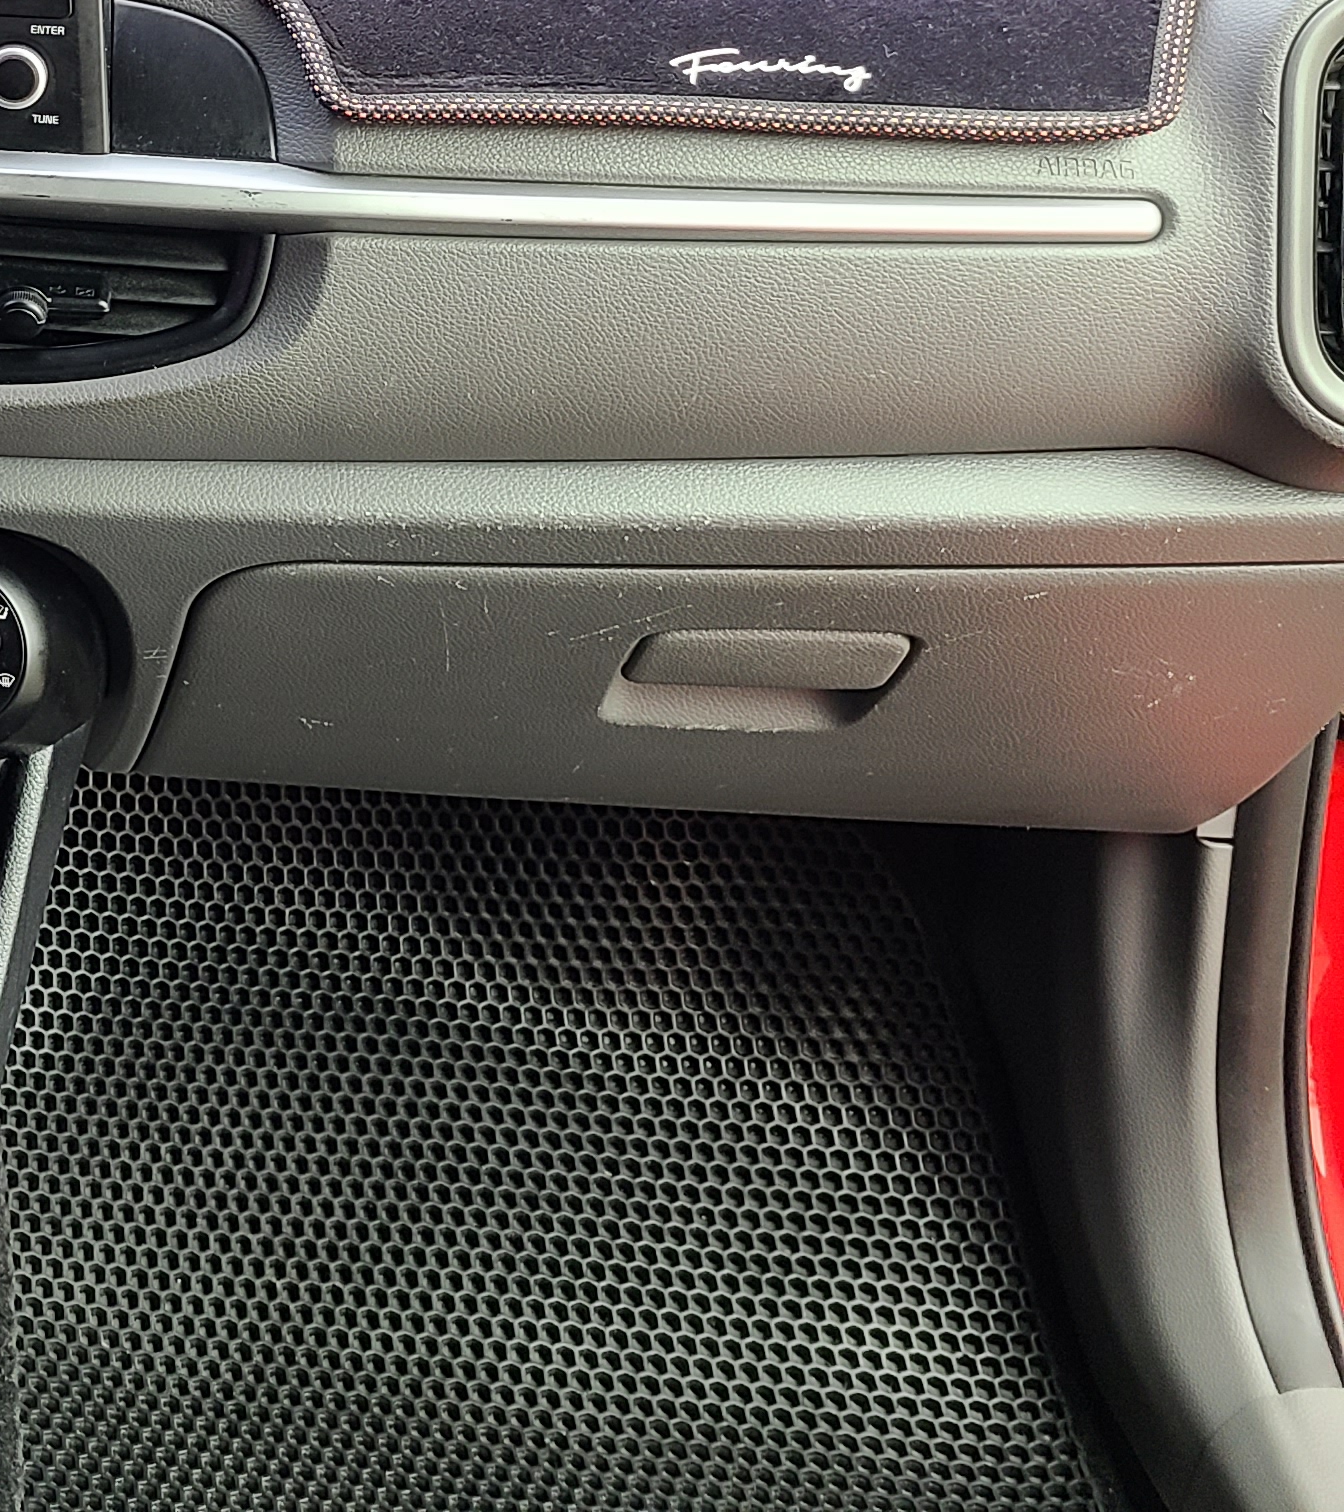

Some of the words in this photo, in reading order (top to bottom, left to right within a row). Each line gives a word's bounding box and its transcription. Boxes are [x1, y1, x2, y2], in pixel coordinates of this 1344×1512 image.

[30, 24, 65, 36] ENTER
[32, 114, 60, 125] TUNE
[1037, 156, 1135, 180] AIRBAG
